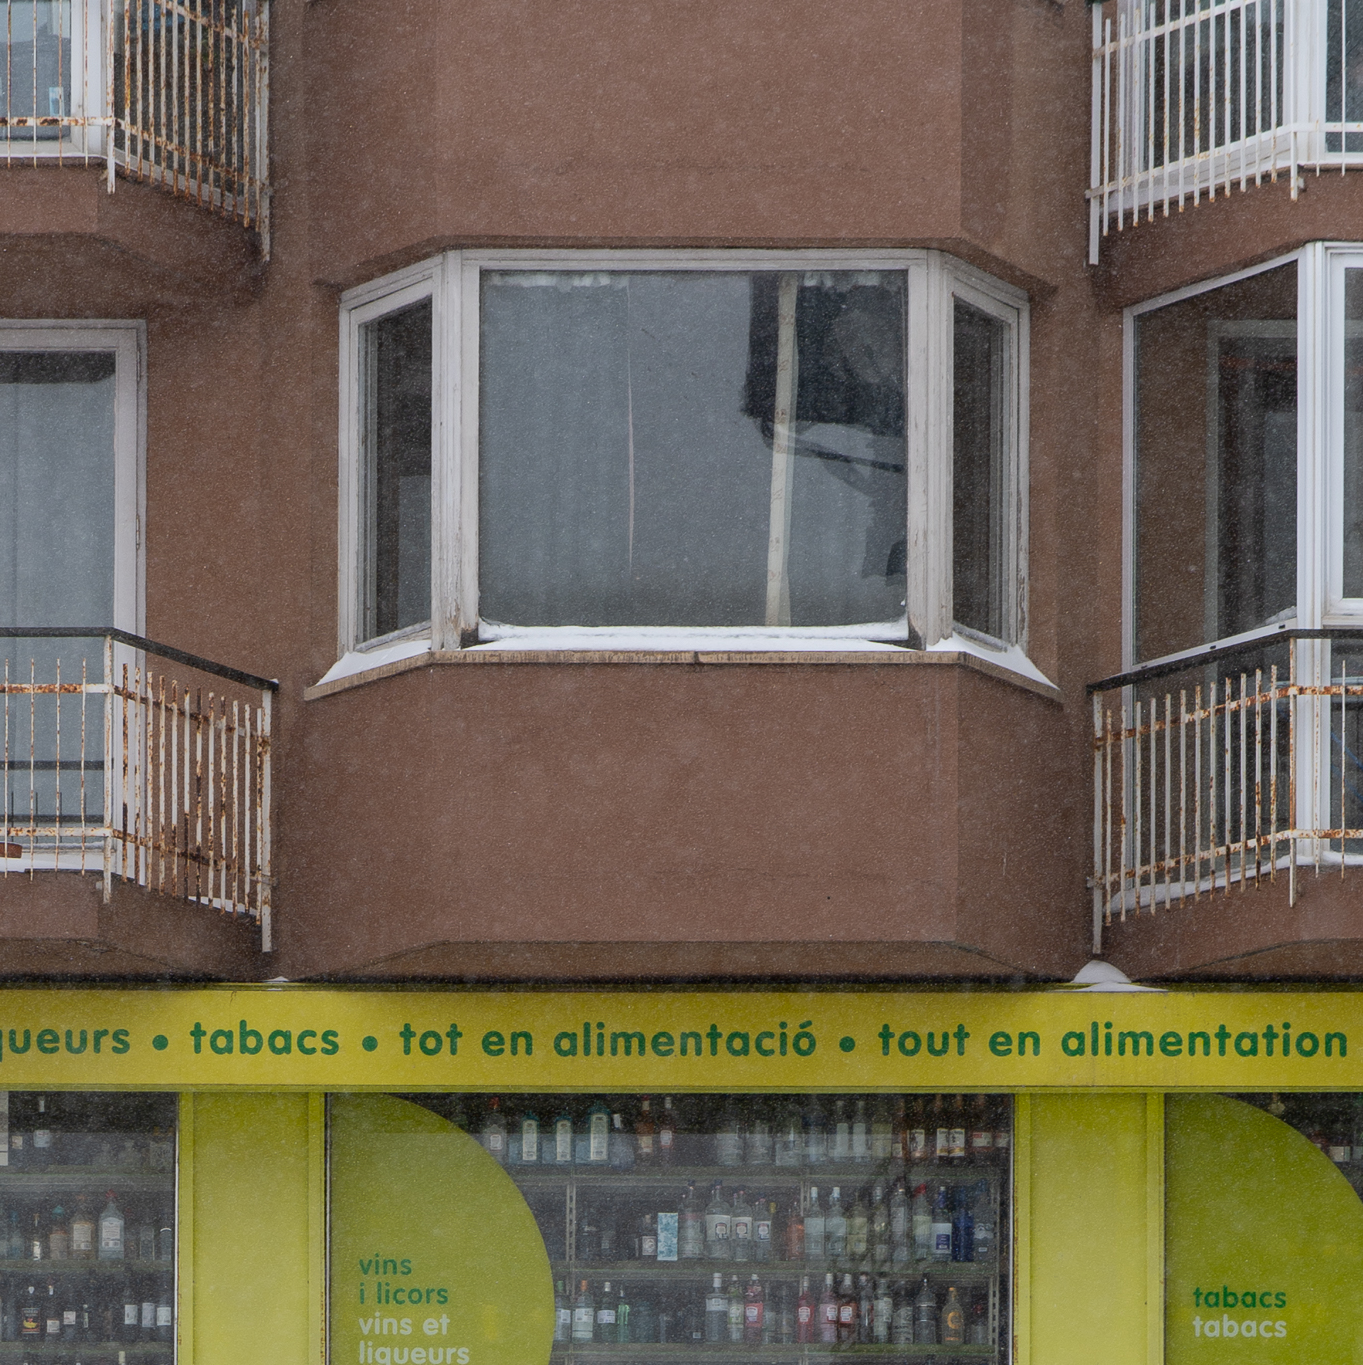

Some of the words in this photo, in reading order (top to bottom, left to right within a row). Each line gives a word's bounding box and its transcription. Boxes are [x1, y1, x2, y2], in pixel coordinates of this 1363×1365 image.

[189, 1019, 340, 1056] tabacs
[398, 1022, 464, 1057] tot
[480, 1029, 534, 1057] en
[553, 1019, 817, 1058] alimentació
[877, 1022, 971, 1058] tout
[988, 1029, 1041, 1057] en
[1060, 1020, 1348, 1059] alimentation
[359, 1252, 412, 1275] vins
[359, 1282, 365, 1305] i
[376, 1281, 449, 1305] licors
[1193, 1285, 1287, 1308] tabacs
[358, 1311, 413, 1336] vins
[422, 1313, 450, 1336] et
[1192, 1313, 1287, 1338] tabacs
